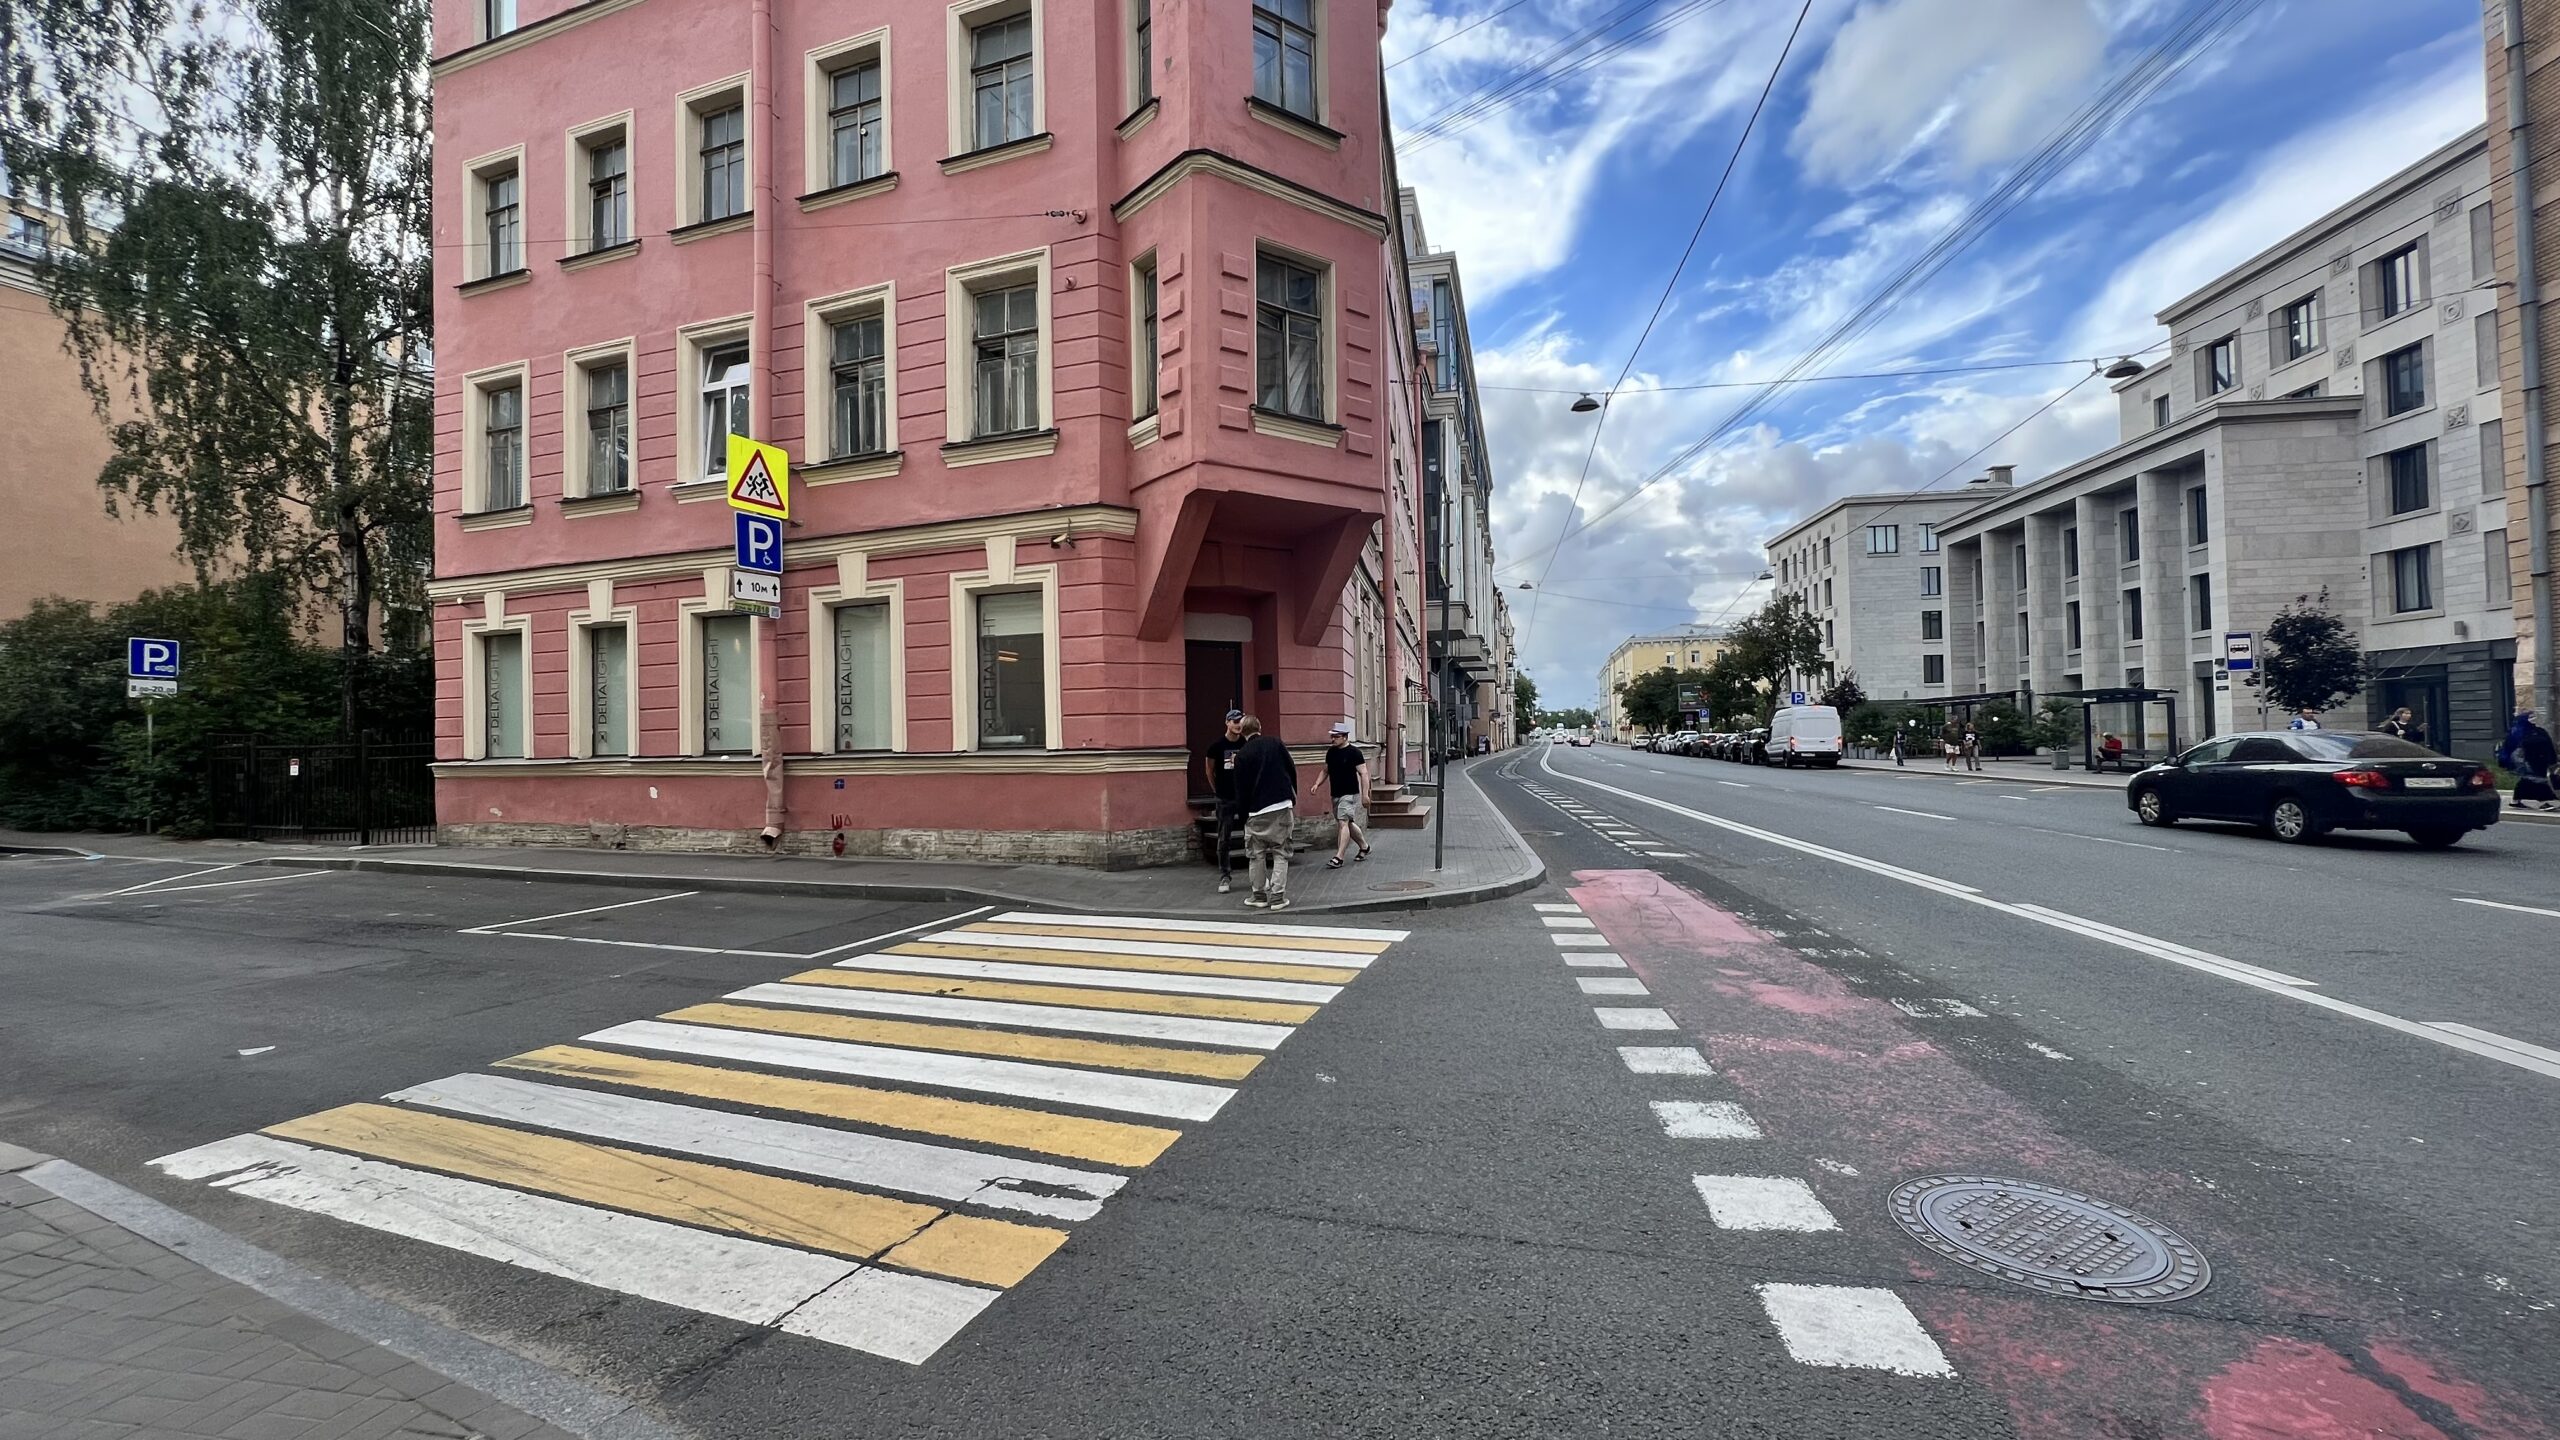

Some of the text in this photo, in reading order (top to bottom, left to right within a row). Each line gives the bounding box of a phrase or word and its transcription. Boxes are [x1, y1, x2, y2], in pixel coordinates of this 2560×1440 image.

[749, 521, 773, 563] P
[144, 644, 169, 672] P
[1795, 693, 1802, 703] P
